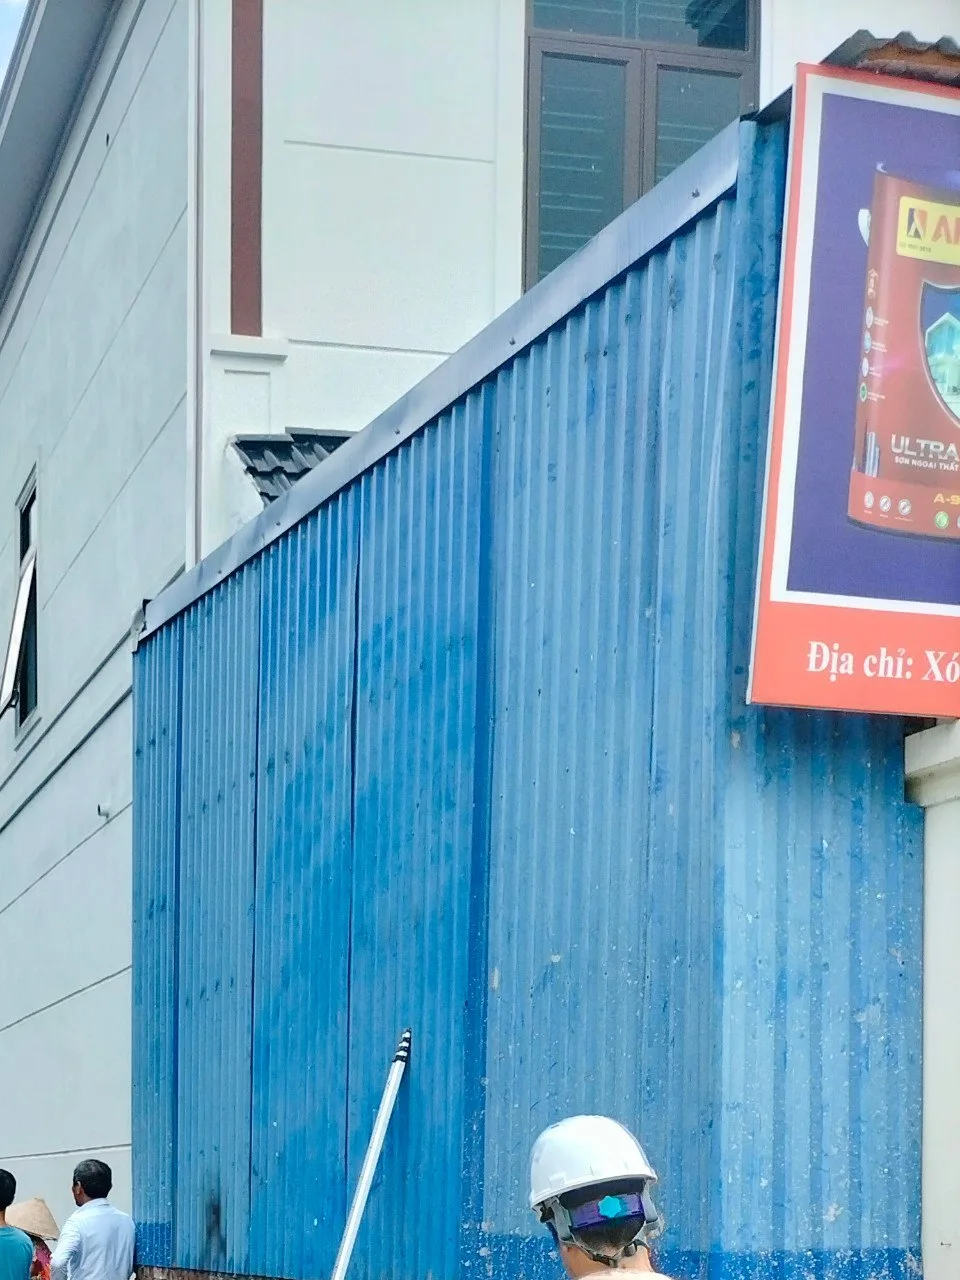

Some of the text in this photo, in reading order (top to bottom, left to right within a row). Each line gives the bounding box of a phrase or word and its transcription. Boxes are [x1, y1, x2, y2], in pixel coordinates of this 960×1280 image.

[892, 434, 960, 462] ULTRA
[806, 640, 960, 683] Địa chỉ: Xó
